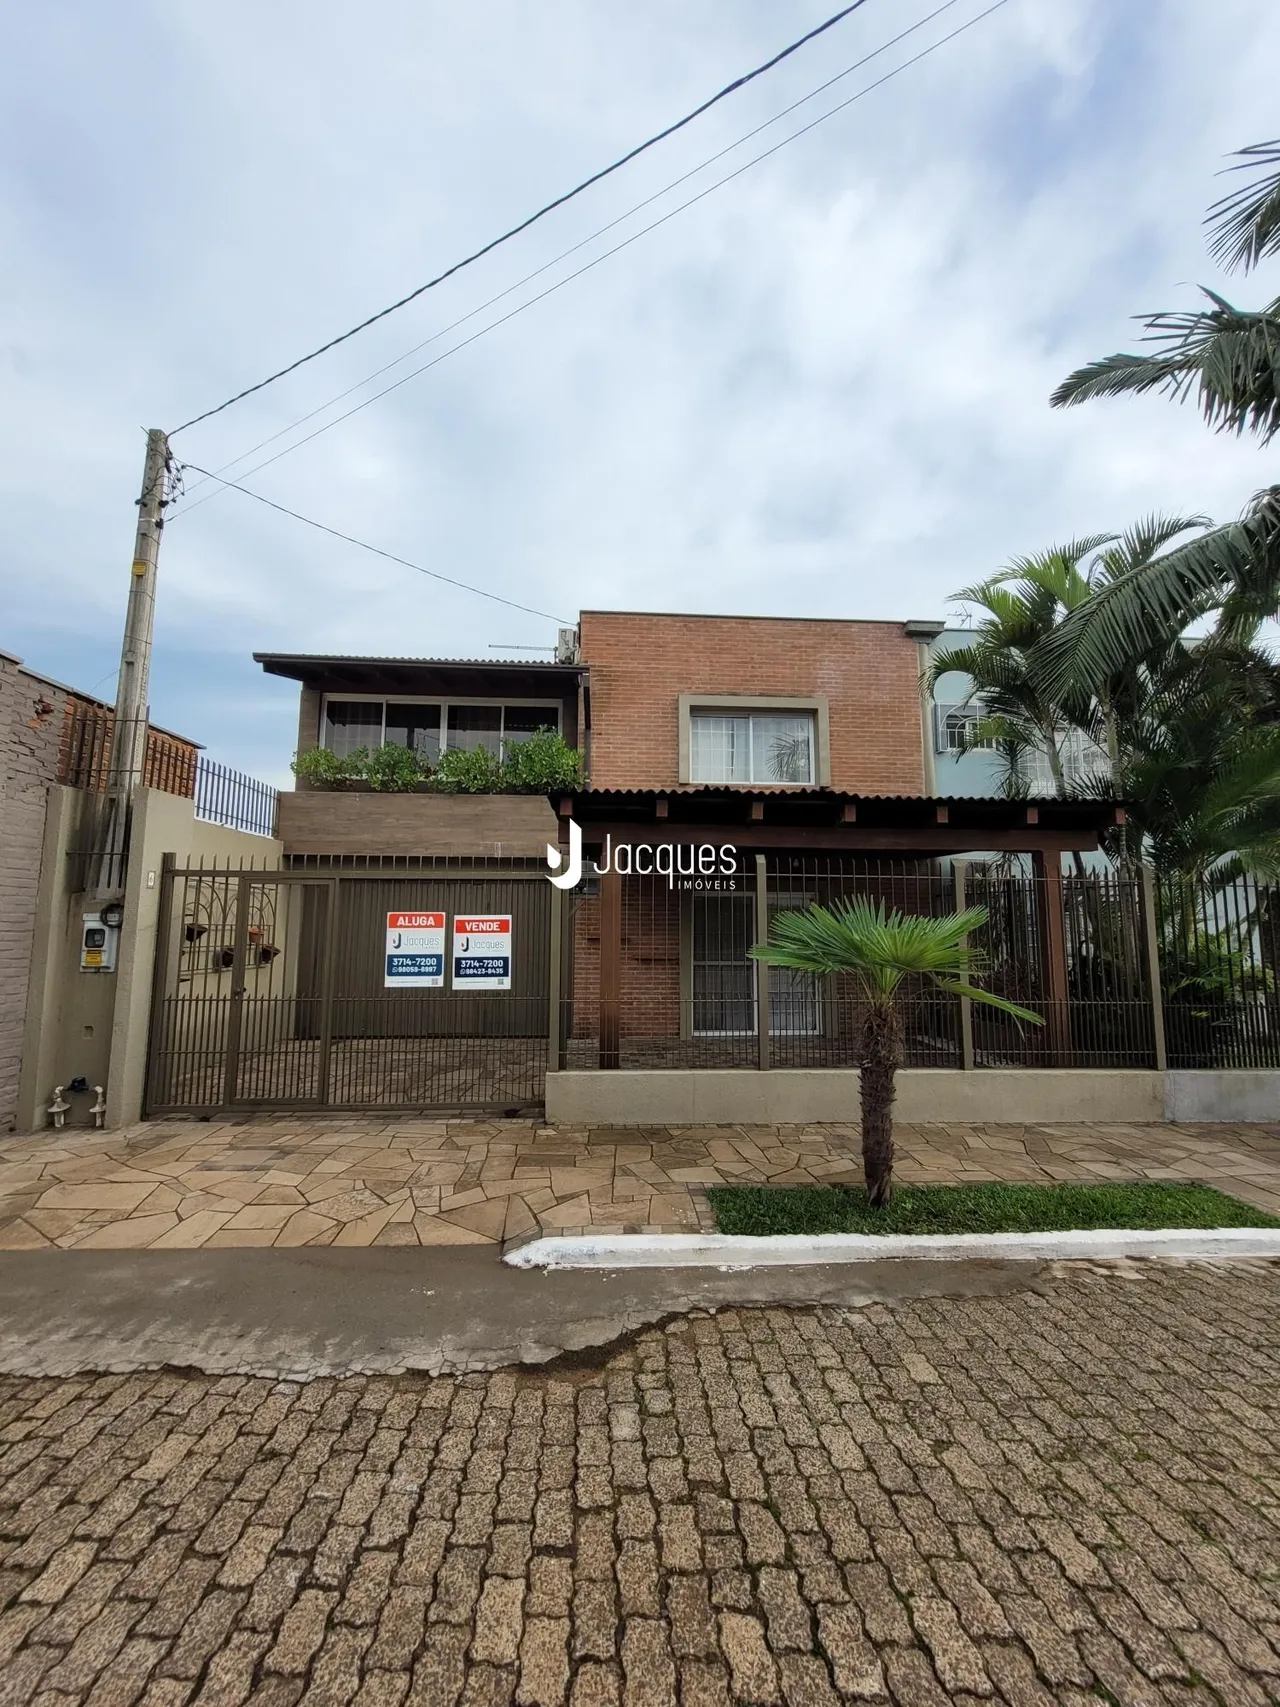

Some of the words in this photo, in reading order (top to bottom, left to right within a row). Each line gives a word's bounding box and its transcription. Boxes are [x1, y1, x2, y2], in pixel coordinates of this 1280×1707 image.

[397, 916, 435, 926] ALUGA
[465, 922, 501, 932] VENDE
[404, 936, 440, 949] Jacques
[472, 939, 505, 952] Jacques
[392, 958, 437, 966] 3714-7200
[460, 959, 504, 968] 3714-7200
